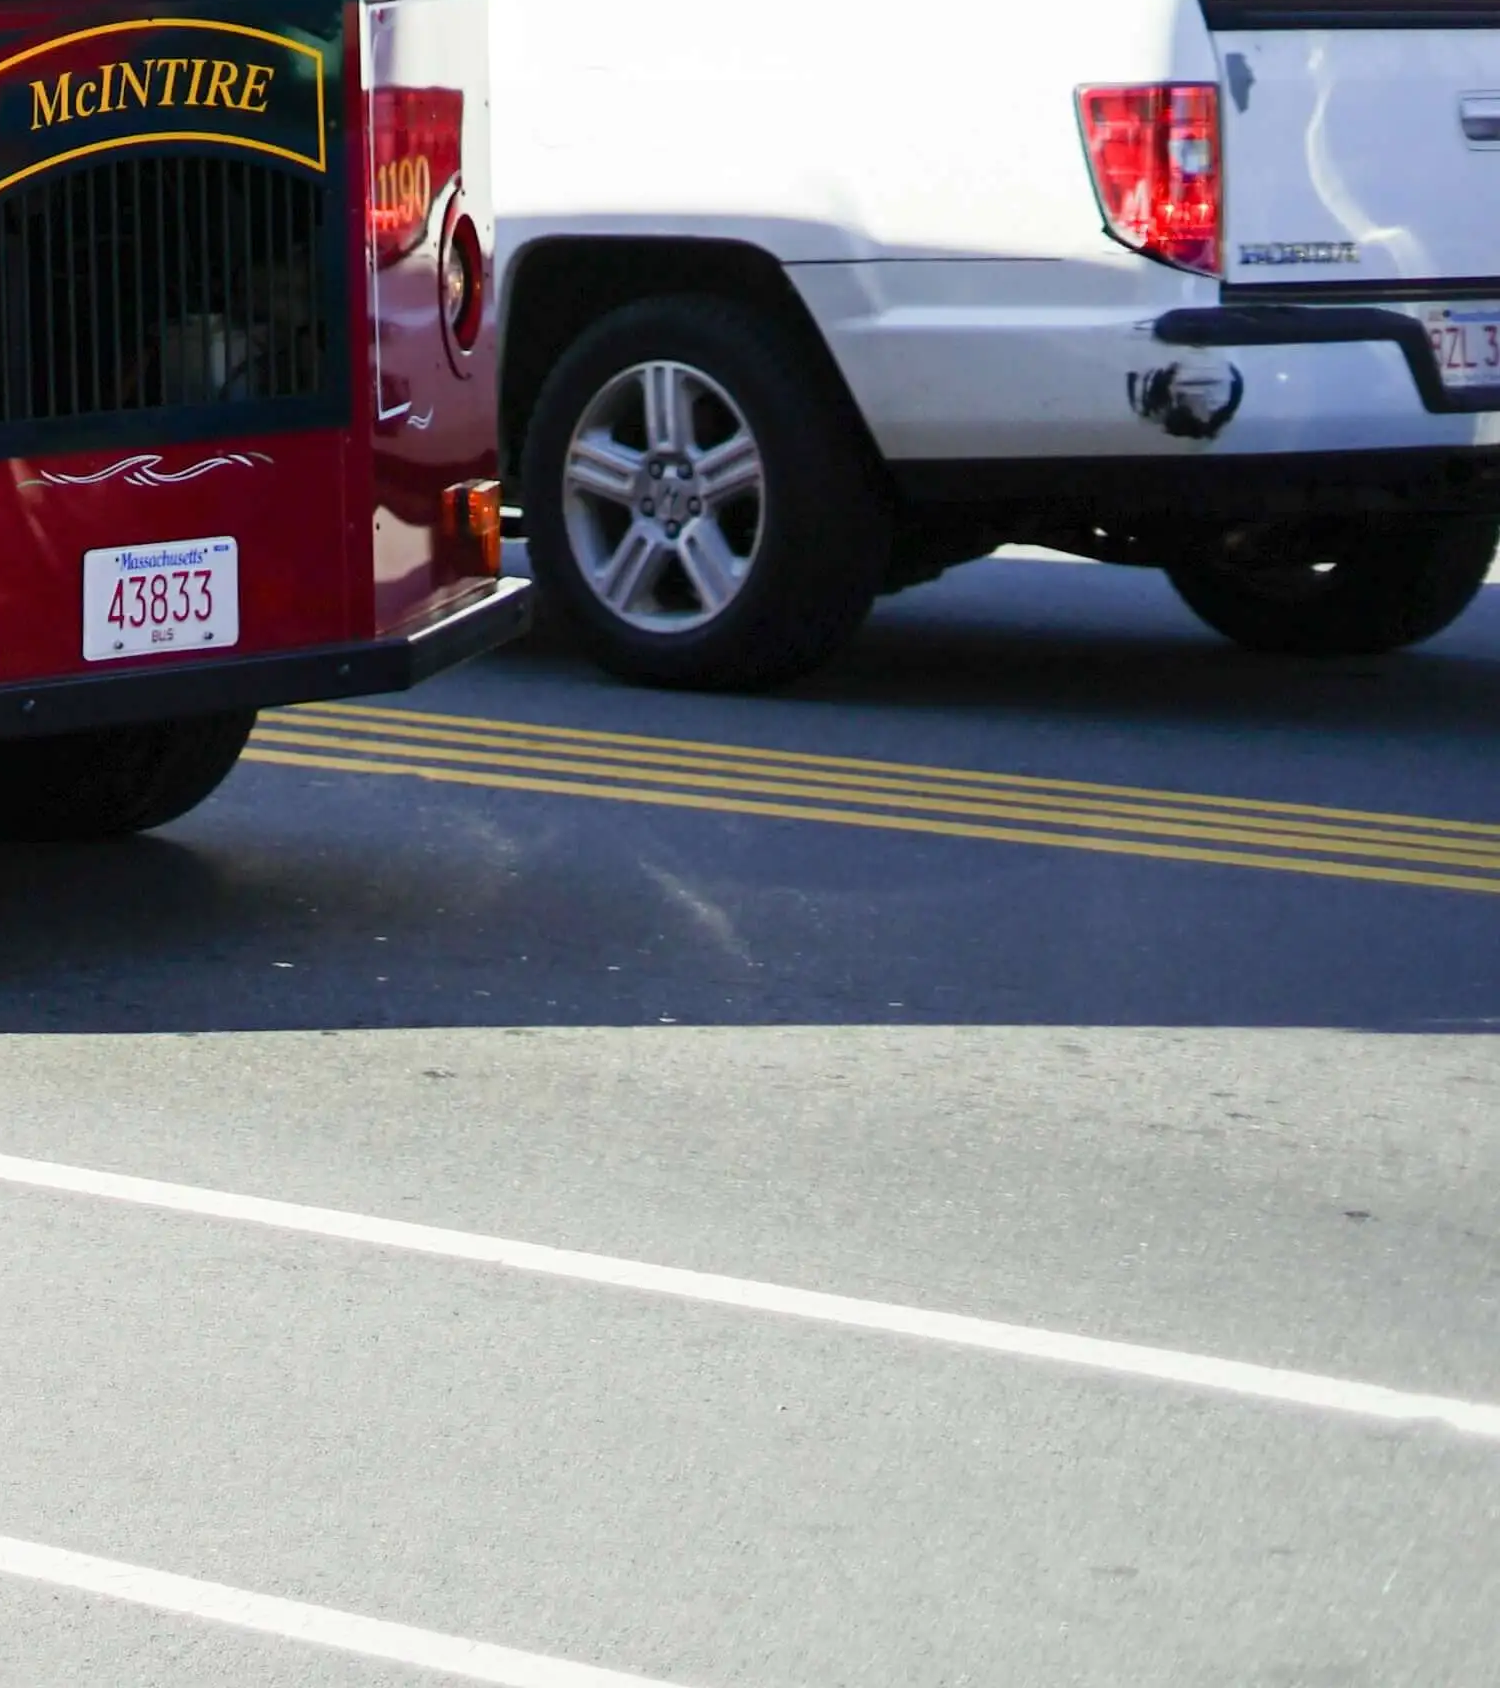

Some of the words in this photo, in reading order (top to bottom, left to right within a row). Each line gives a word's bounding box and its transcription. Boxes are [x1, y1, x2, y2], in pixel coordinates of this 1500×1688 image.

[29, 58, 275, 131] McINTIRE
[377, 154, 431, 230] 1190
[120, 548, 203, 571] Massachusetts
[107, 569, 213, 630] 43833
[151, 628, 175, 644] BUS
